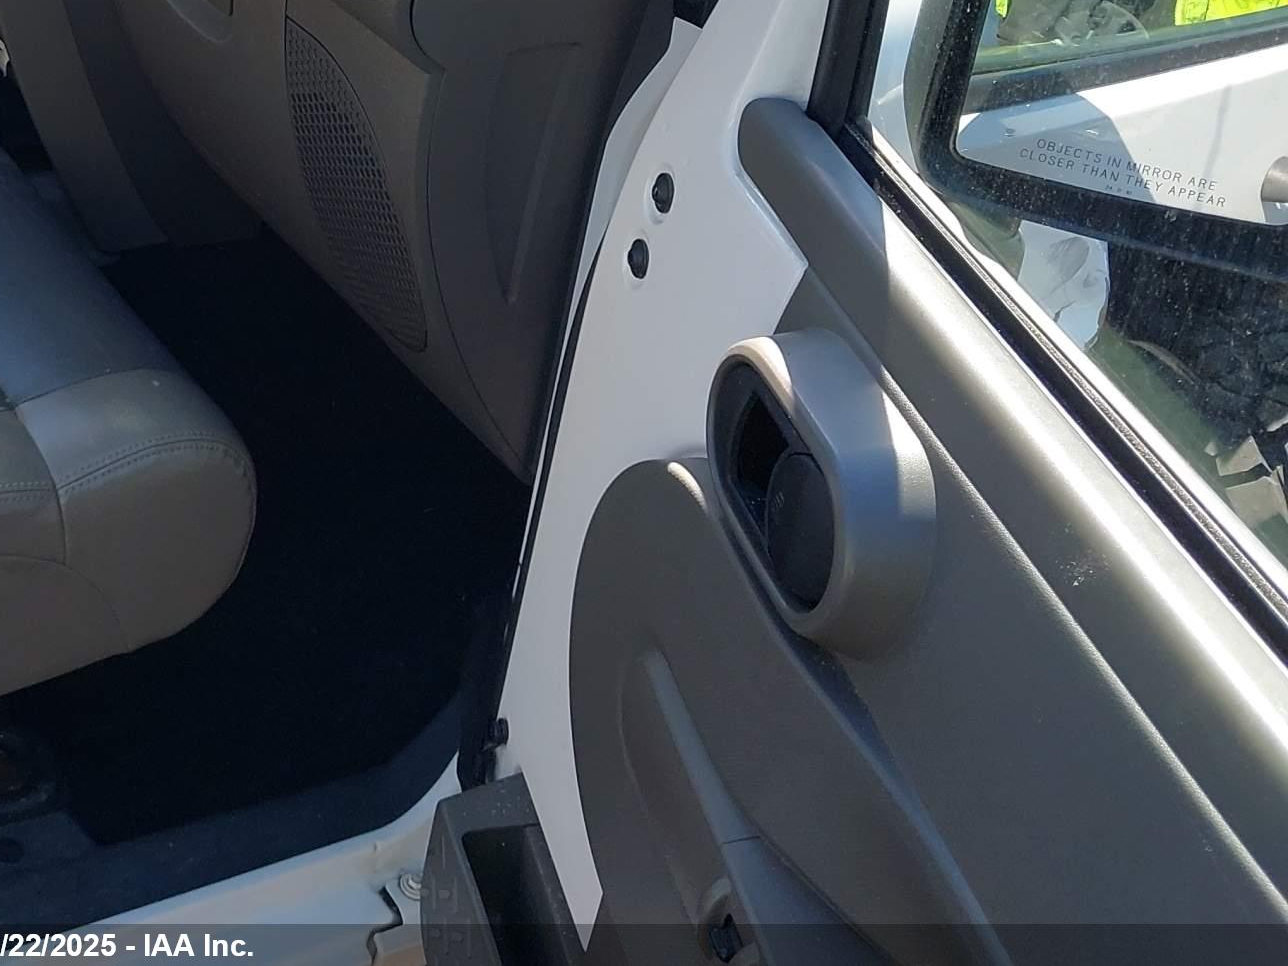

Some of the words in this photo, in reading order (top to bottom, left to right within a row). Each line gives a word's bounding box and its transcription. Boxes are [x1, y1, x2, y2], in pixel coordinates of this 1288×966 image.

[1020, 148, 1074, 170] CLOSER
[1082, 163, 1119, 182] THAN
[1126, 174, 1163, 191] THEY
[1168, 185, 1226, 207] APPEAR
[1037, 138, 1102, 163] OBJECTS
[1107, 156, 1122, 168] IN
[1126, 161, 1182, 183] MIRROR
[1188, 177, 1218, 191] ARE
